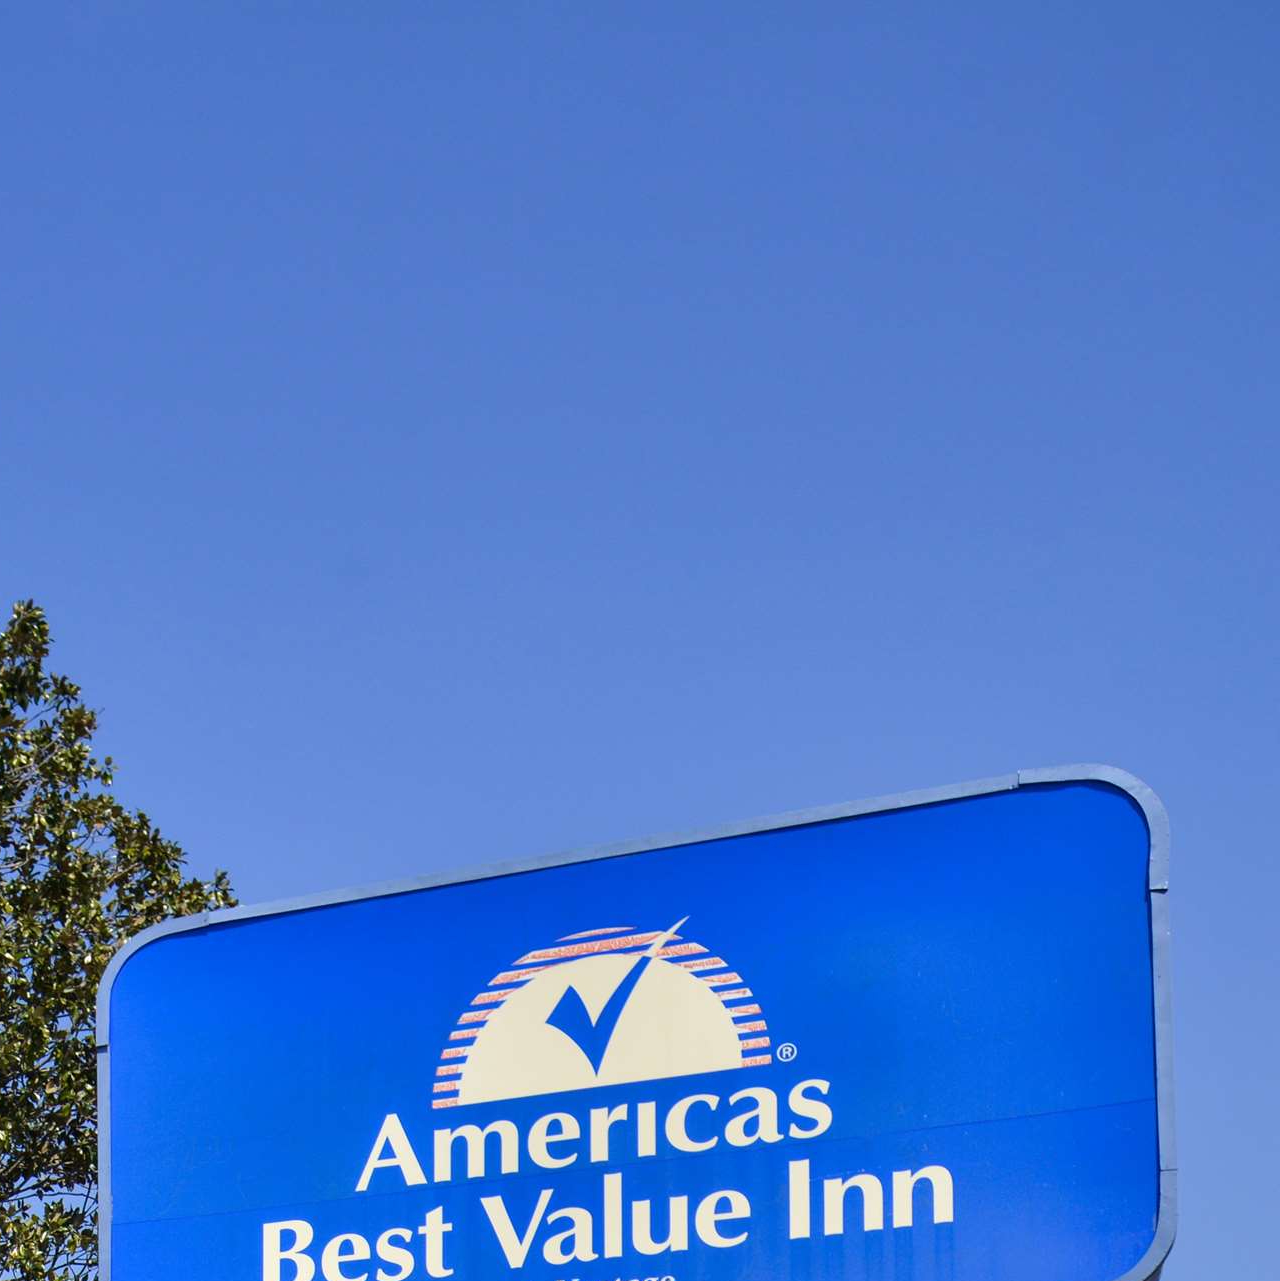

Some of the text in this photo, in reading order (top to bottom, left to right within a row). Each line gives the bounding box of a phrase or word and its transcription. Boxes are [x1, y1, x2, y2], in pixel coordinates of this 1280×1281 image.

[355, 1078, 833, 1192] Americas
[480, 1173, 751, 1270] Value
[788, 1159, 954, 1239] Inn
